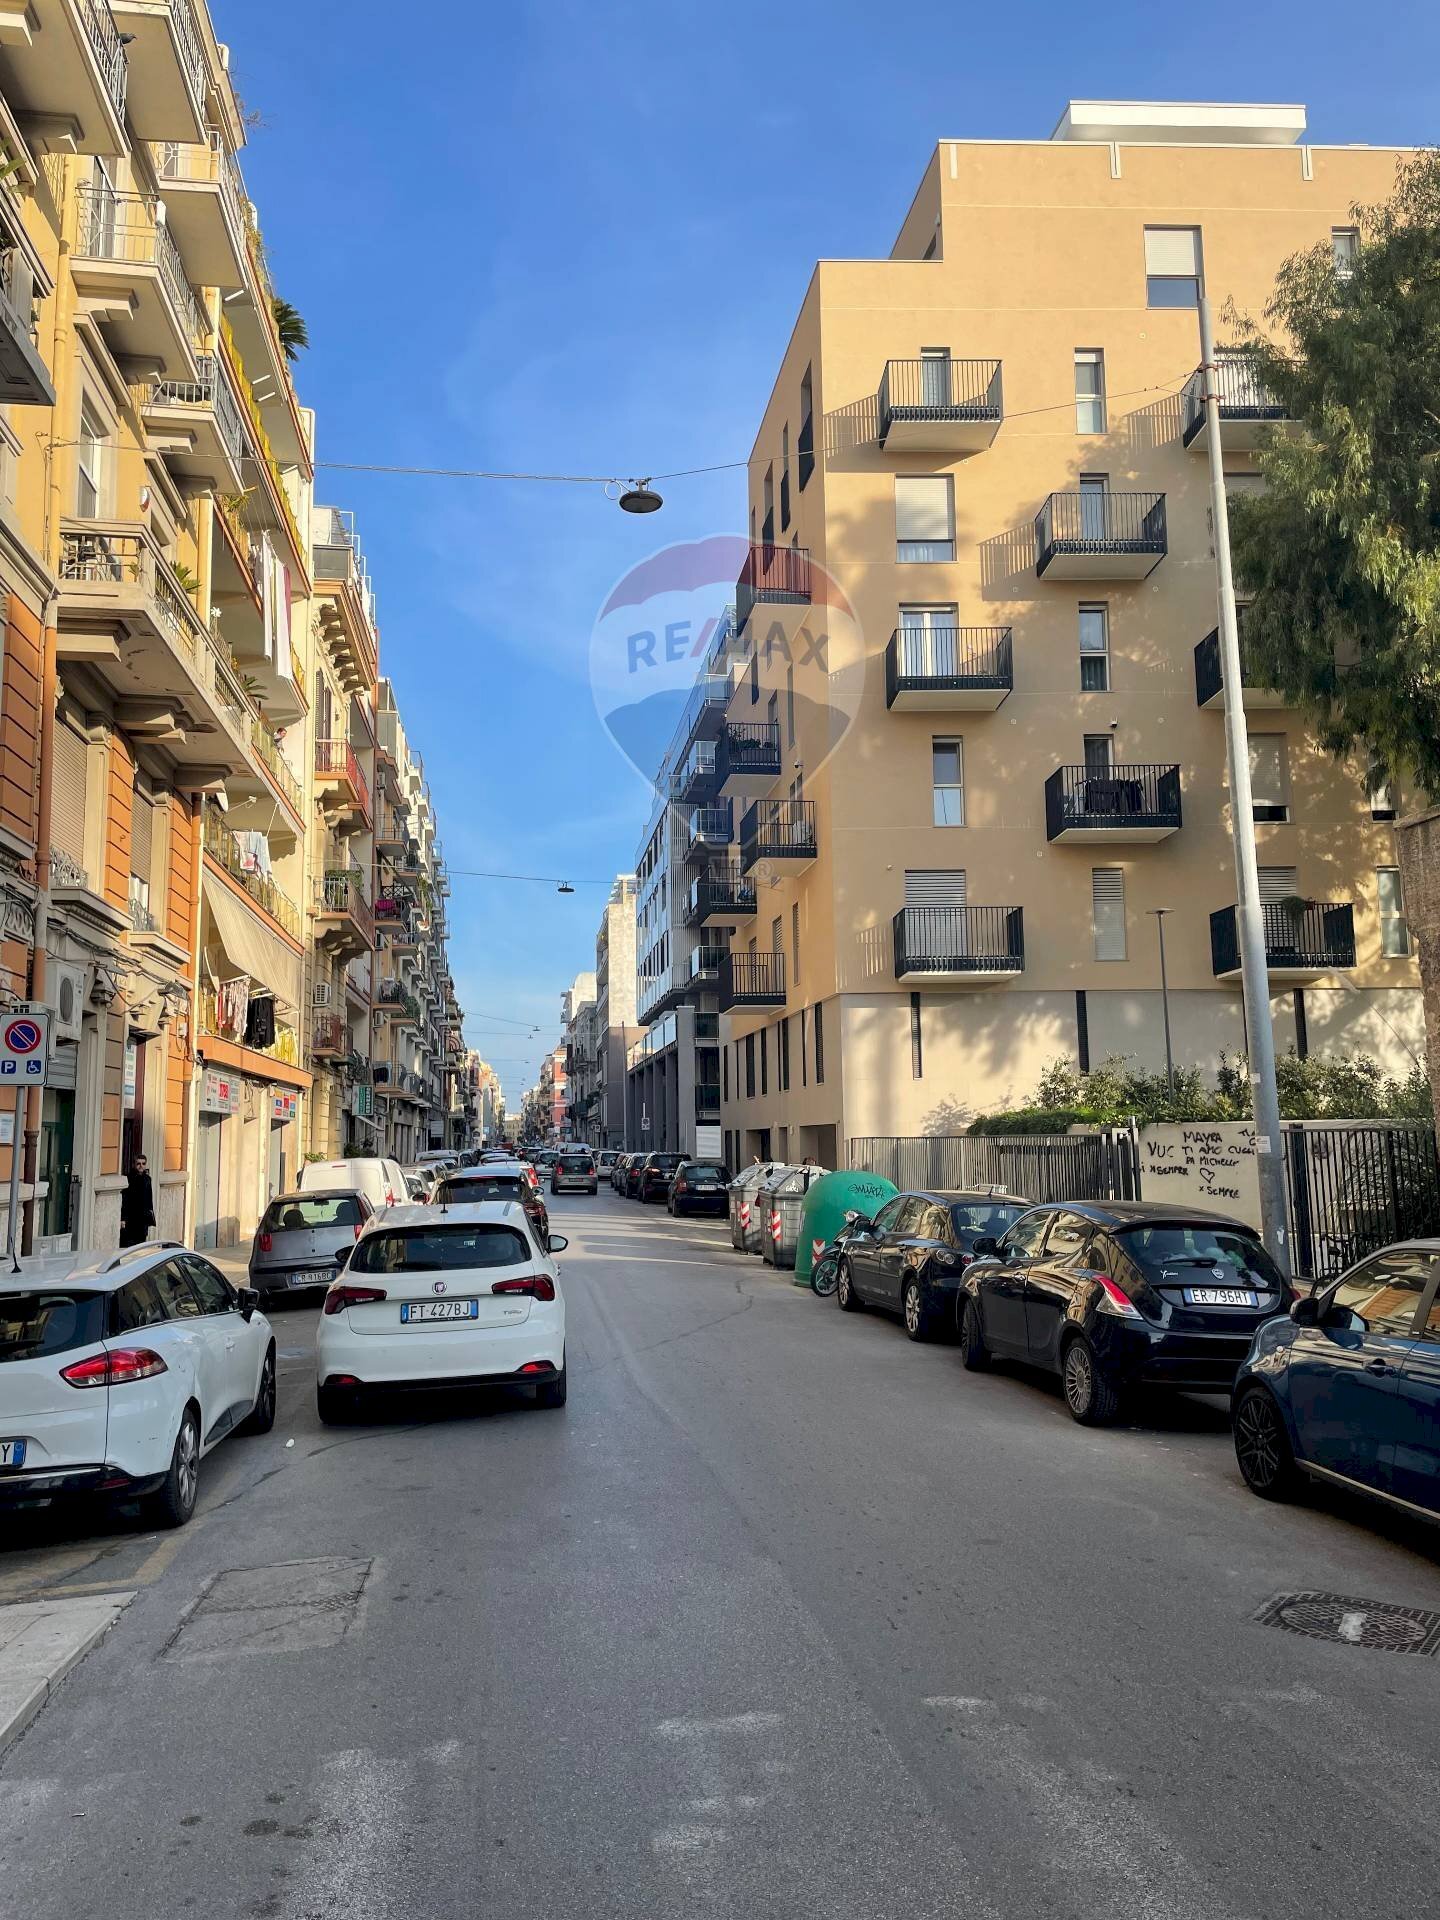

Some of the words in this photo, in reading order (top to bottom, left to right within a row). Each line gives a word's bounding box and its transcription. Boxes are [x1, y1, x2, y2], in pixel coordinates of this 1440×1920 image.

[4, 1062, 14, 1073] P
[1192, 1289, 1207, 1302] ER
[1211, 1290, 1248, 1304] 796HT
[410, 1305, 426, 1319] FT
[430, 1302, 469, 1317] 427BJ
